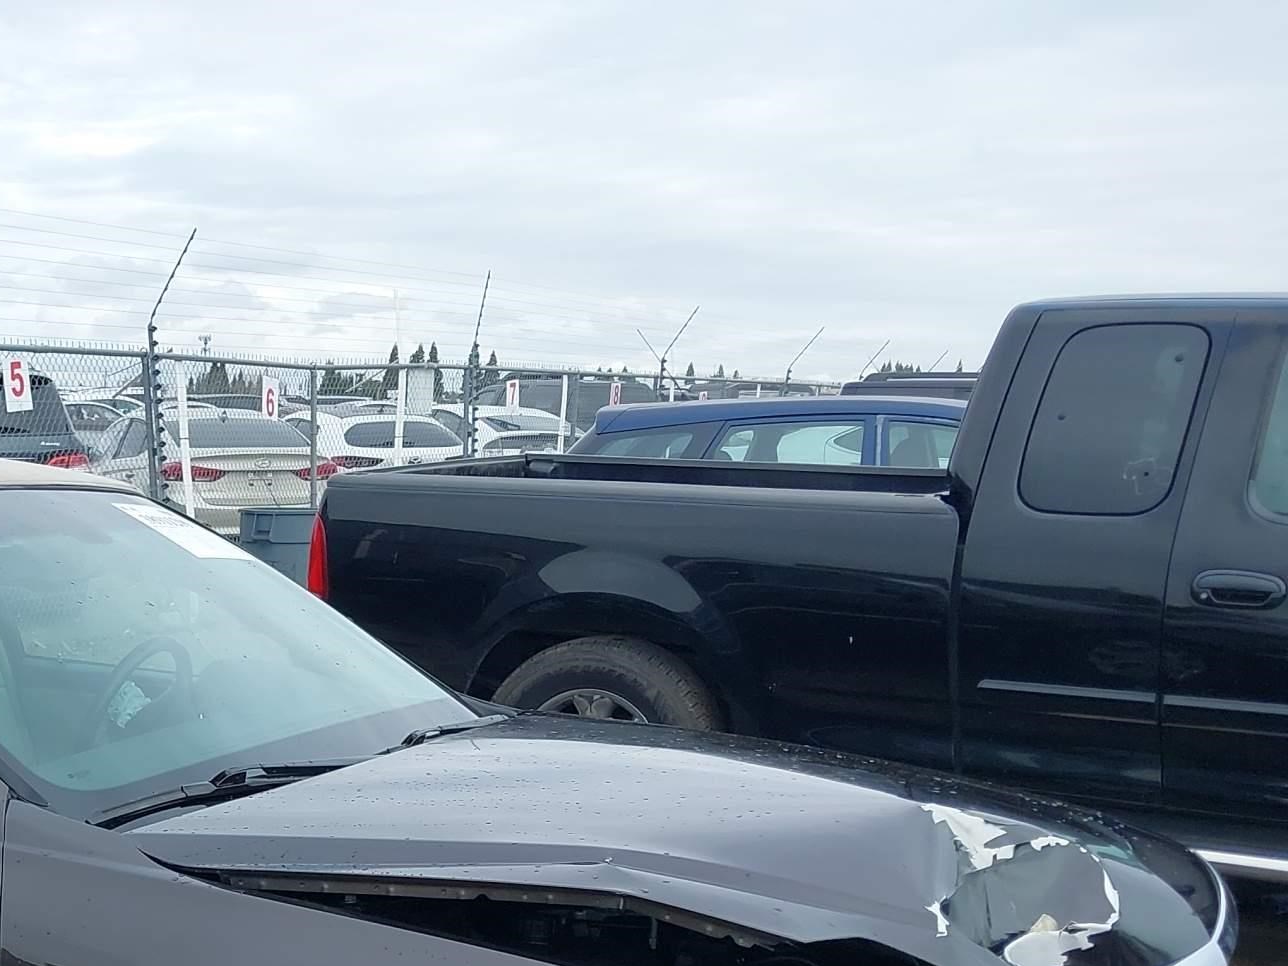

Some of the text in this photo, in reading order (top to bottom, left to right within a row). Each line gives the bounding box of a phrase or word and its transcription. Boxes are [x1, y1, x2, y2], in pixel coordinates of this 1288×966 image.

[10, 361, 24, 397] 5
[266, 388, 274, 417] 6
[509, 382, 516, 405] 7
[613, 385, 619, 405] 8
